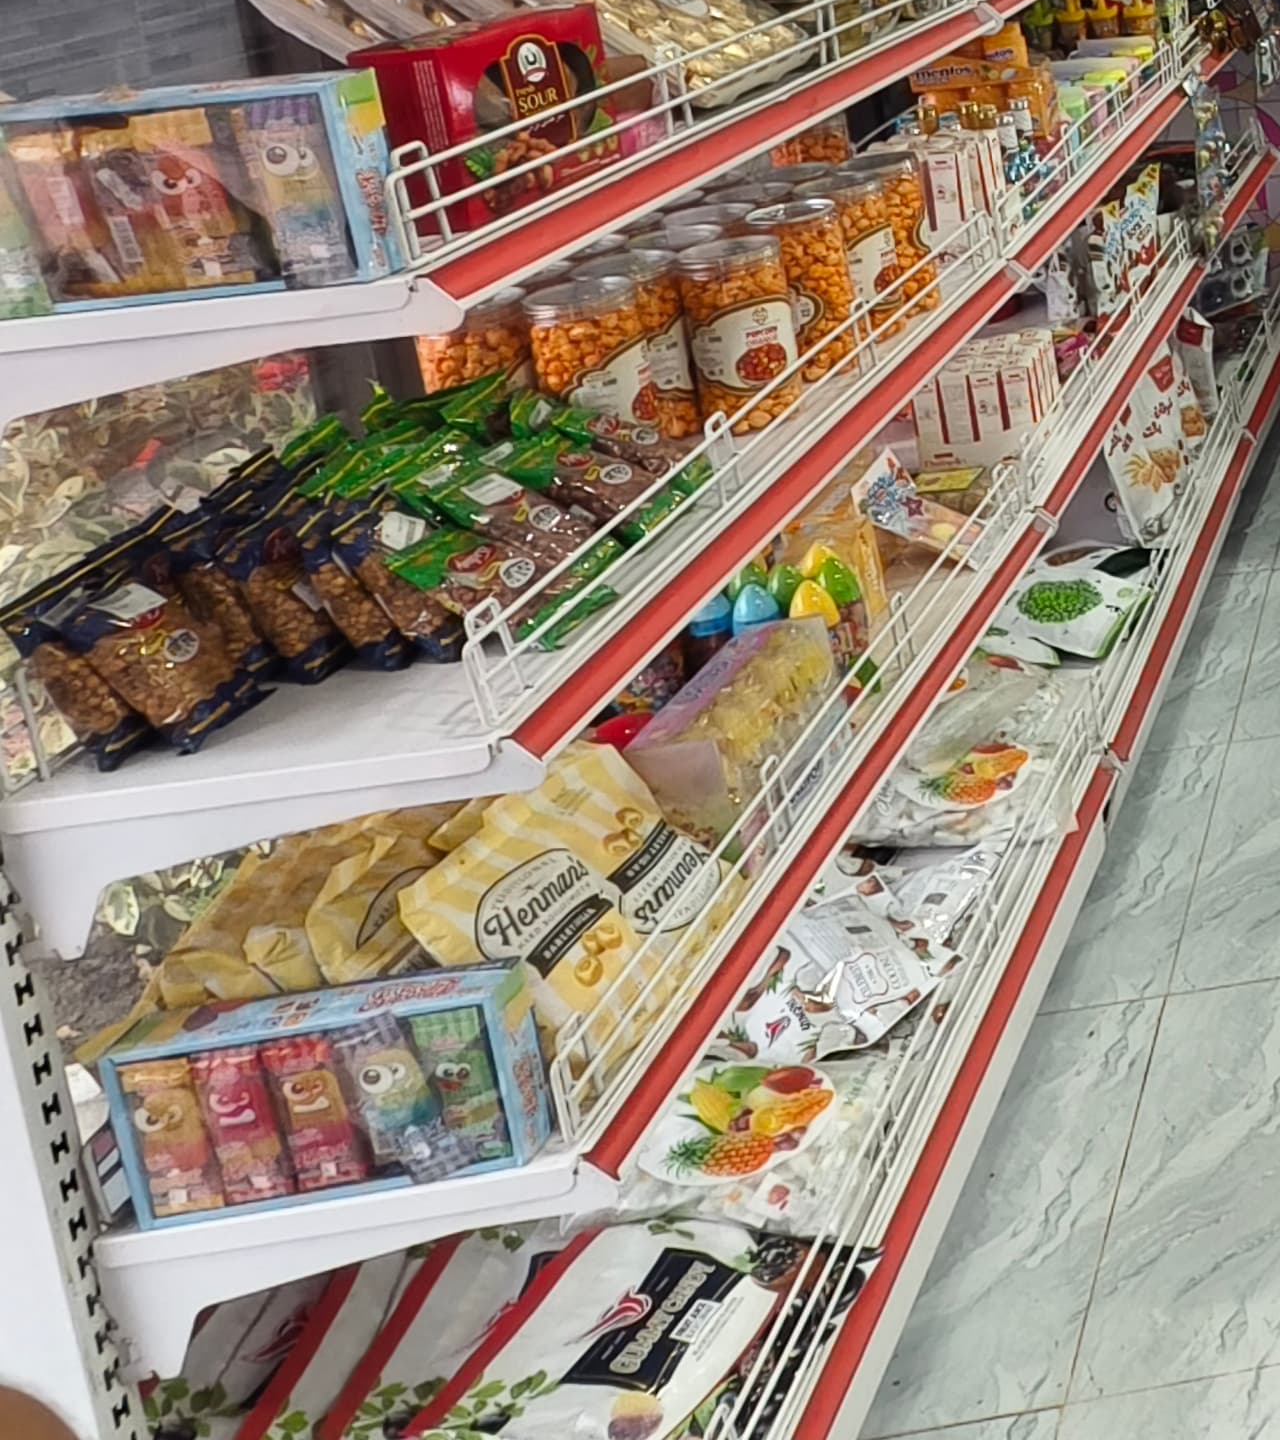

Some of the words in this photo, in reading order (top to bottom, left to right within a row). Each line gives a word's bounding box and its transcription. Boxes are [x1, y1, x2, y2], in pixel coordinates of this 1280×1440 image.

[915, 64, 972, 82] mentos
[518, 86, 559, 113] SOUR
[483, 855, 590, 947] Henman's
